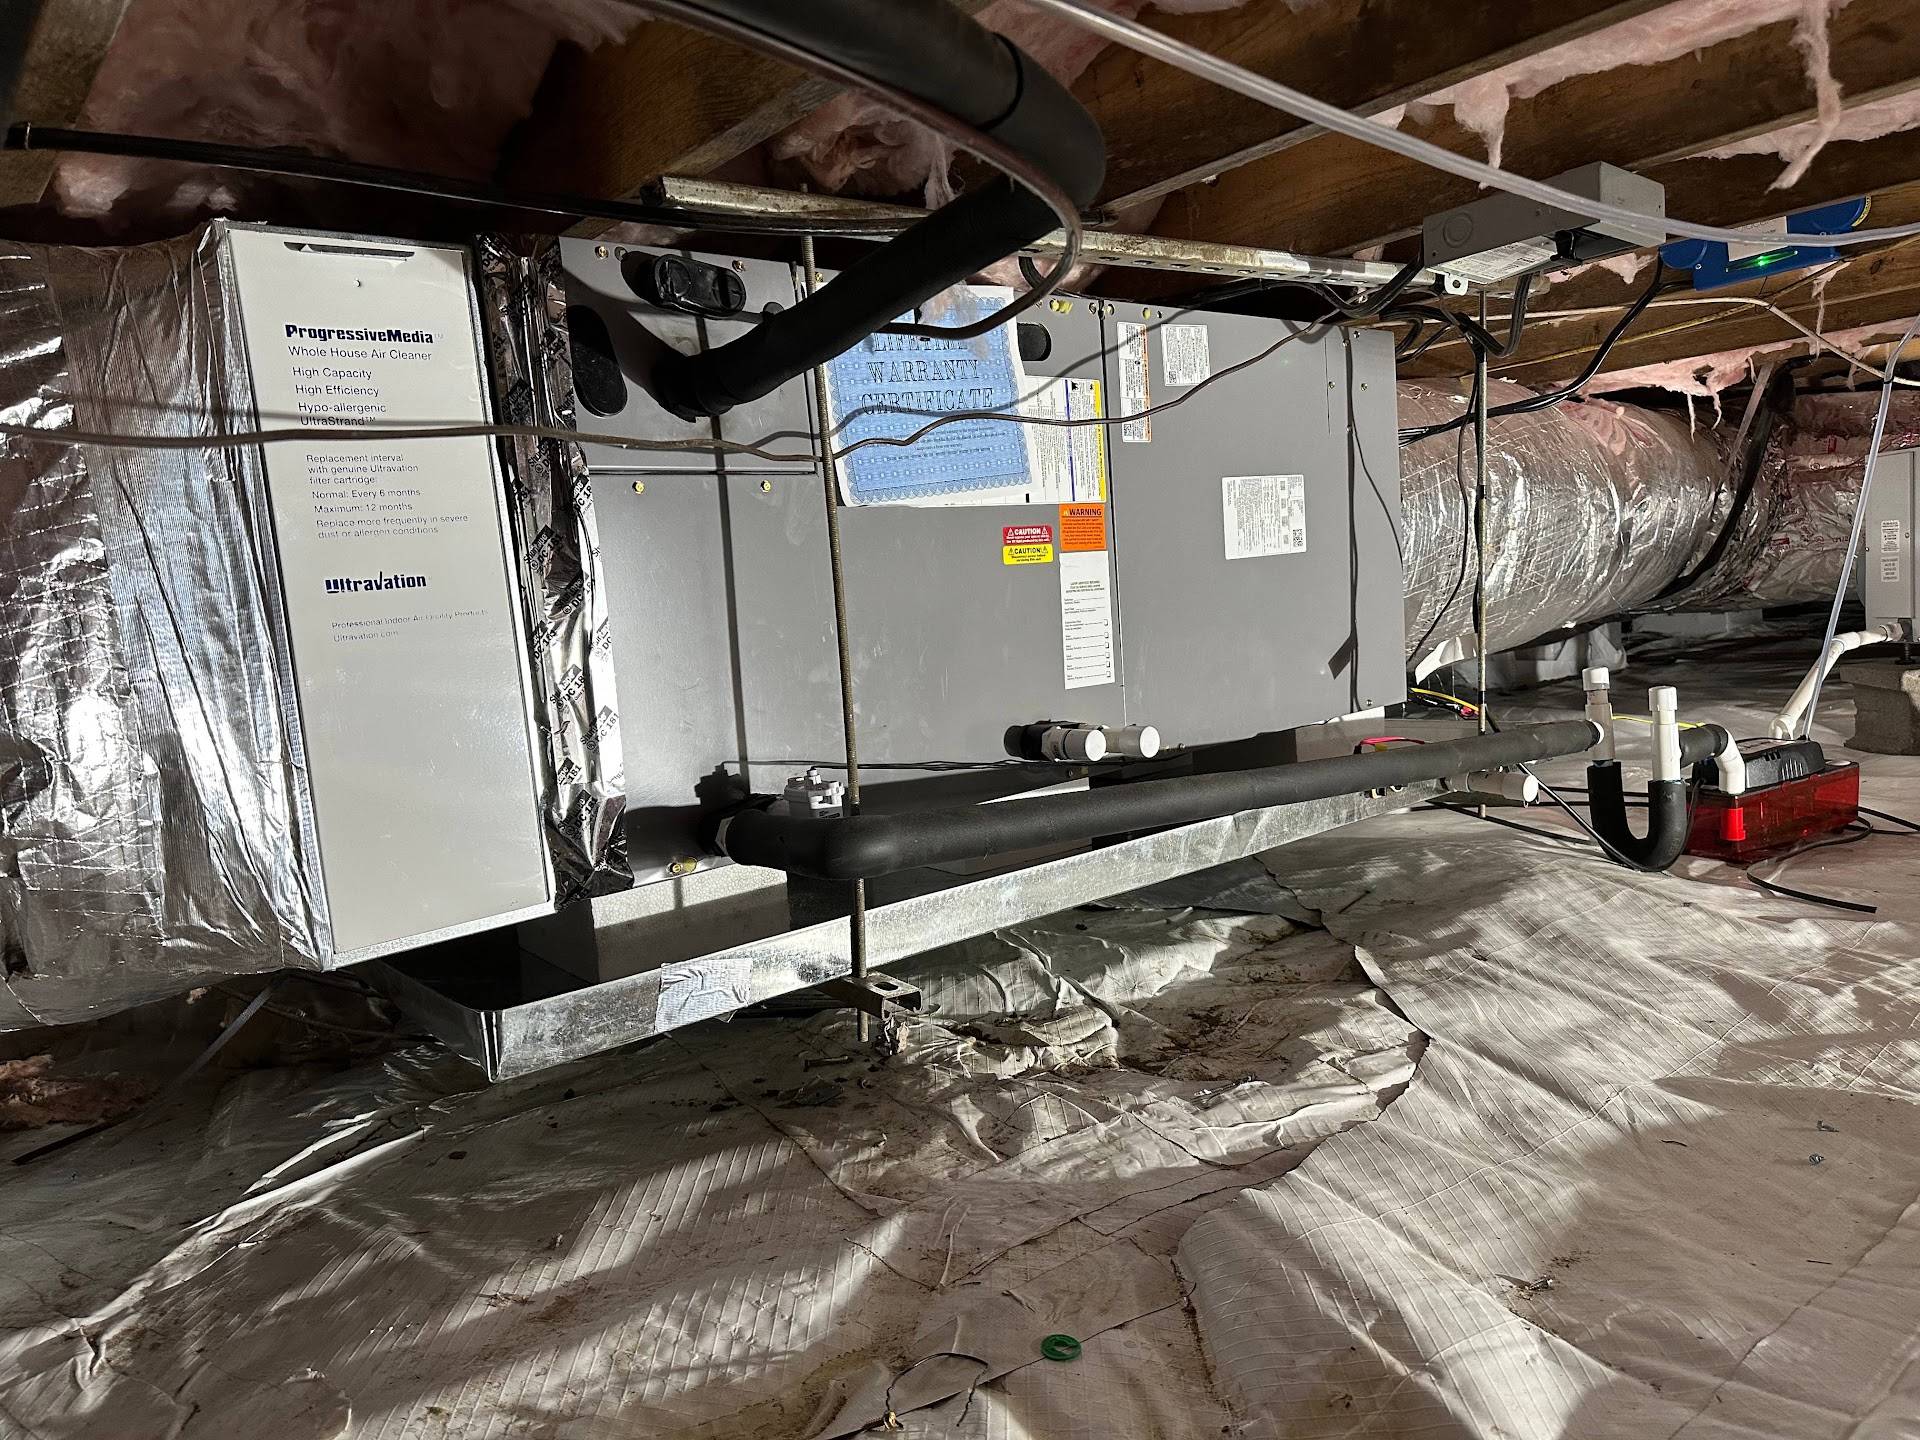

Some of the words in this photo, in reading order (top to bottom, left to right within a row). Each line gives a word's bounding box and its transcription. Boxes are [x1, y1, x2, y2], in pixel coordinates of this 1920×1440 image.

[288, 346, 327, 357] Whole
[330, 348, 368, 359] House
[371, 349, 386, 359] Air
[389, 349, 432, 361] Cleaner
[292, 367, 319, 378] High
[322, 367, 372, 380] Capacity
[866, 359, 979, 383] WARRANTY
[295, 384, 322, 396] High
[325, 385, 379, 397] Efficiency
[861, 387, 993, 415] CERTIFICATE
[298, 402, 386, 414] Hypo-allergenic
[306, 454, 368, 464] Replacement
[308, 466, 328, 474] with
[330, 466, 368, 475] genuine
[370, 464, 418, 473] Ultravation
[309, 476, 331, 485] filter
[312, 491, 349, 499] Normal:
[351, 490, 377, 499] Every
[379, 489, 386, 498] 6
[387, 489, 421, 497] months
[314, 504, 363, 513] Maximum:
[366, 503, 377, 512] 12
[379, 502, 413, 511] months
[1069, 508, 1102, 516] WARNING
[316, 519, 355, 528] Replace
[357, 518, 381, 526] more
[383, 516, 428, 526] frequently
[440, 514, 468, 523] severe
[318, 530, 339, 539] dust
[354, 528, 390, 538] allergen
[392, 526, 439, 535] conditions
